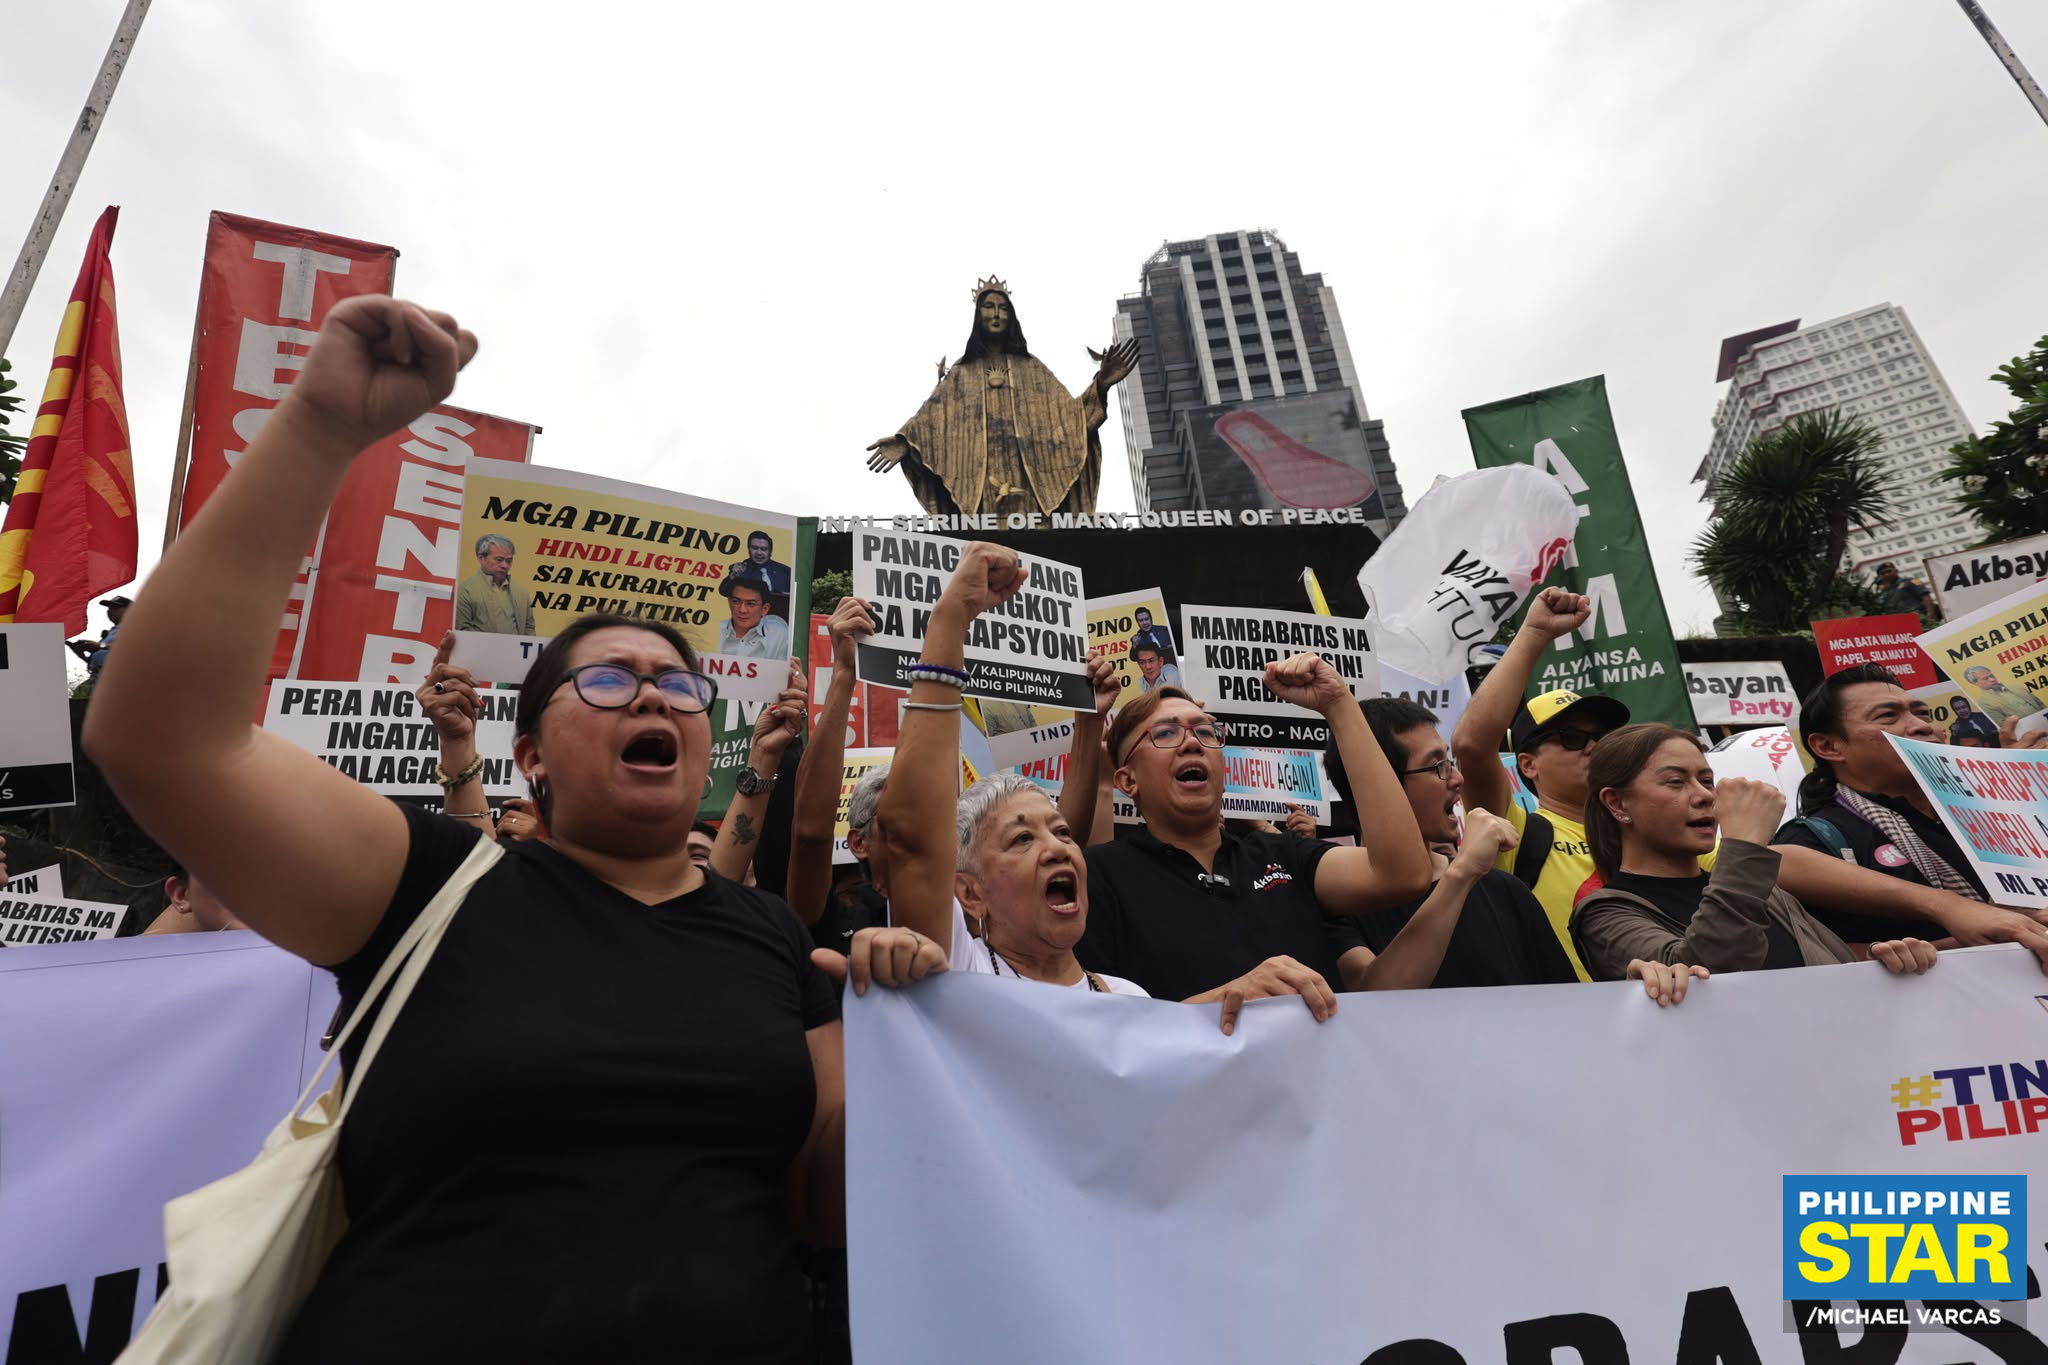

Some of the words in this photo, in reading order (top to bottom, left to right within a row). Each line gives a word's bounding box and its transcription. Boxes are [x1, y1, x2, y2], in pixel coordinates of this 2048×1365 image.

[481, 496, 578, 529] MGA
[580, 509, 740, 556] PILIPINO
[893, 513, 999, 531] SHRINE
[1007, 512, 1043, 531] OF
[1052, 511, 1133, 531] MARY,
[1141, 510, 1233, 528] QUEEN
[1240, 508, 1274, 526] OF
[1282, 507, 1365, 525] PEACE
[535, 538, 624, 565] HINDI
[625, 552, 723, 580] LIGTAS
[533, 564, 573, 585] SA
[575, 569, 715, 602] KURAKOT
[1030, 560, 1078, 598] ANG
[530, 590, 573, 612] NA
[575, 595, 710, 626] PULITIKO
[876, 568, 941, 604] MGA
[981, 591, 1072, 628] NGKOT
[872, 602, 904, 637] SA
[913, 609, 1088, 664] KAPSYON!
[1190, 616, 1339, 649] MAMBABATAS
[1343, 628, 1371, 651] NA
[1829, 637, 1855, 651] MGA
[1855, 635, 1879, 648] BATA
[1878, 633, 1914, 645] WALANG
[1946, 628, 2005, 664] MGA
[1204, 645, 1278, 671] KORAP
[1543, 647, 1642, 678] ALYANSA
[1870, 650, 1888, 662] SILA
[1887, 649, 1905, 660] MAY
[1905, 647, 1918, 659] LV
[1997, 634, 2048, 664] HINDI
[981, 665, 1051, 685] KALIPUNAN
[1538, 673, 1595, 694] TIGIL
[1603, 661, 1665, 684] MINA
[2011, 658, 2037, 679] SA
[280, 687, 362, 716] PERA
[370, 690, 414, 717] NG
[1006, 680, 1062, 698] PILIPINAS
[1729, 699, 1793, 718] Party
[710, 737, 752, 755] ALYA
[1029, 723, 1075, 744] TIND
[1277, 761, 1317, 798] AGAIN!
[1908, 749, 1974, 798] MAKE
[1221, 798, 1288, 815] MAMAMAYANG
[1948, 804, 2048, 859] SHAMEFUL
[1995, 872, 2035, 896] ML
[84, 910, 116, 929] NA
